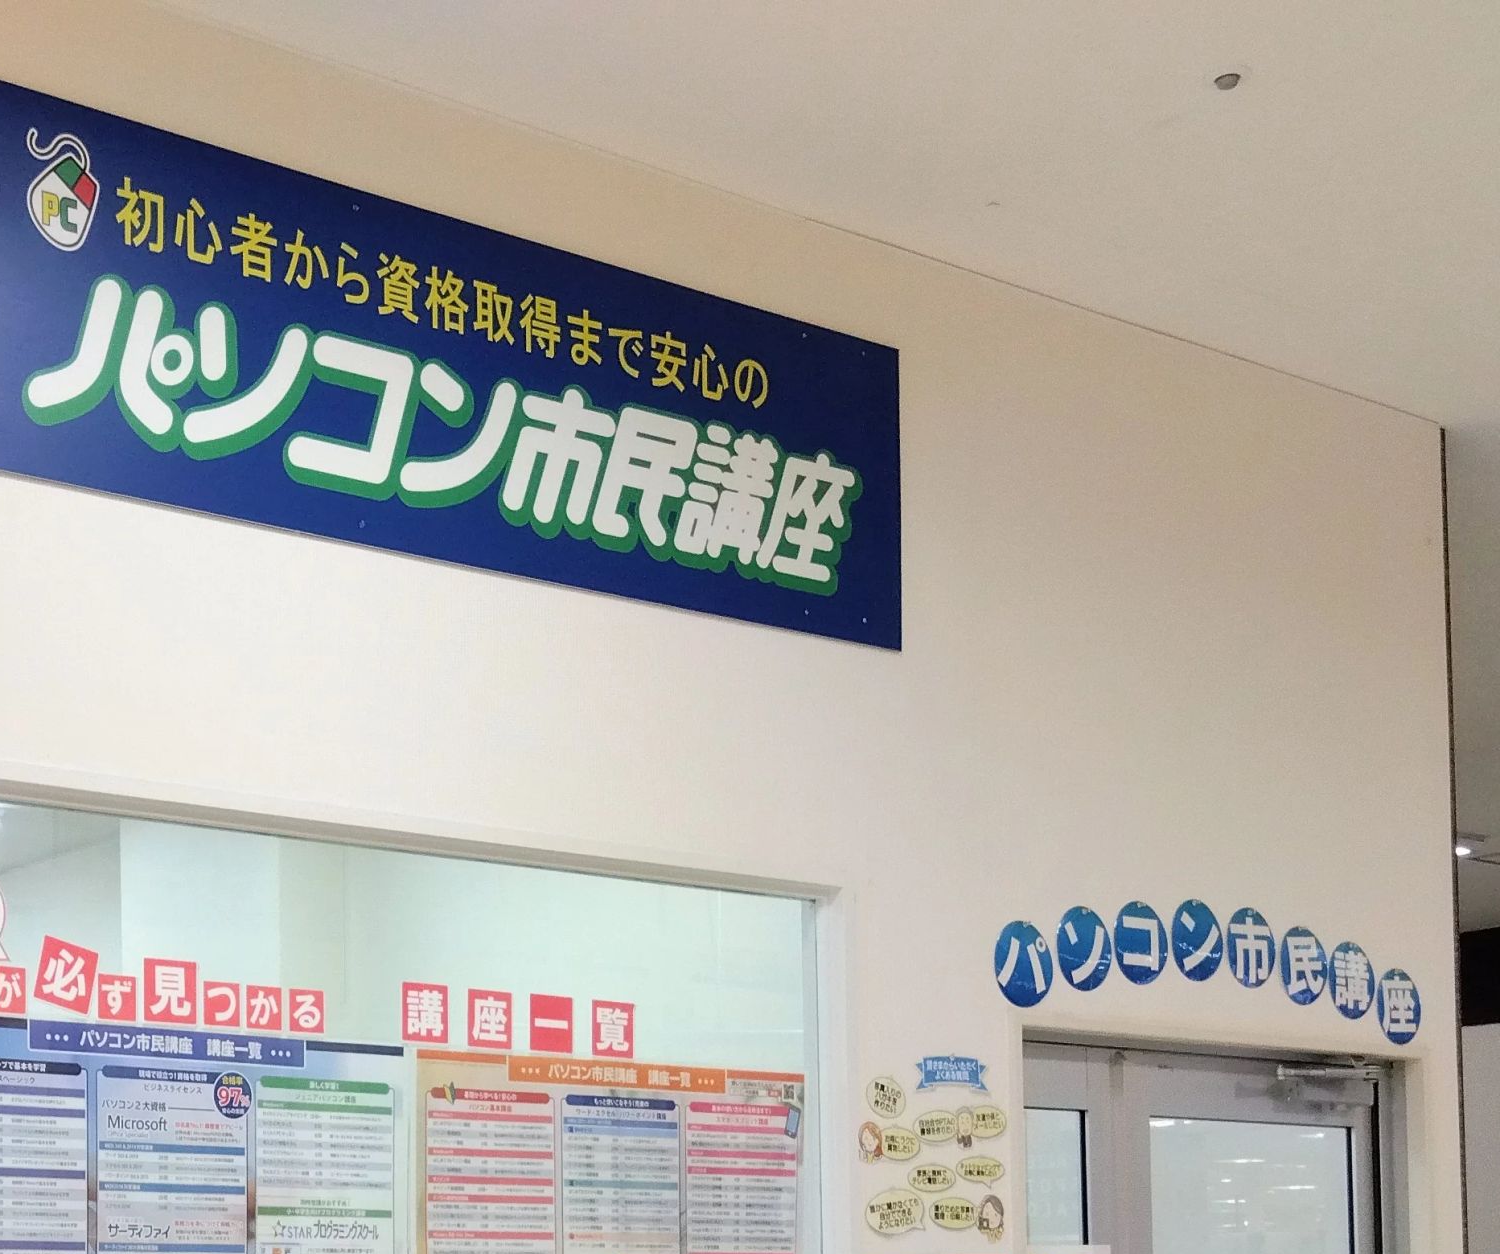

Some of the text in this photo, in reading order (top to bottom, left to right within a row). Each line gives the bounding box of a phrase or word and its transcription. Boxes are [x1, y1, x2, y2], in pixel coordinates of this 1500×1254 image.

[41, 192, 78, 234] PC
[115, 177, 769, 408] 初心者から資格取得まで安心の
[27, 278, 855, 583] パソコン市民講座
[996, 911, 1417, 1034] パソコン市民講座
[406, 988, 629, 1052] 講座一覧
[79, 1031, 263, 1060] パソコン市民講座 講座一覧
[548, 1063, 638, 1085] パソコン市民講座
[107, 1115, 168, 1132] Microsoft
[288, 1219, 379, 1240] STAR プログラミングスクール
